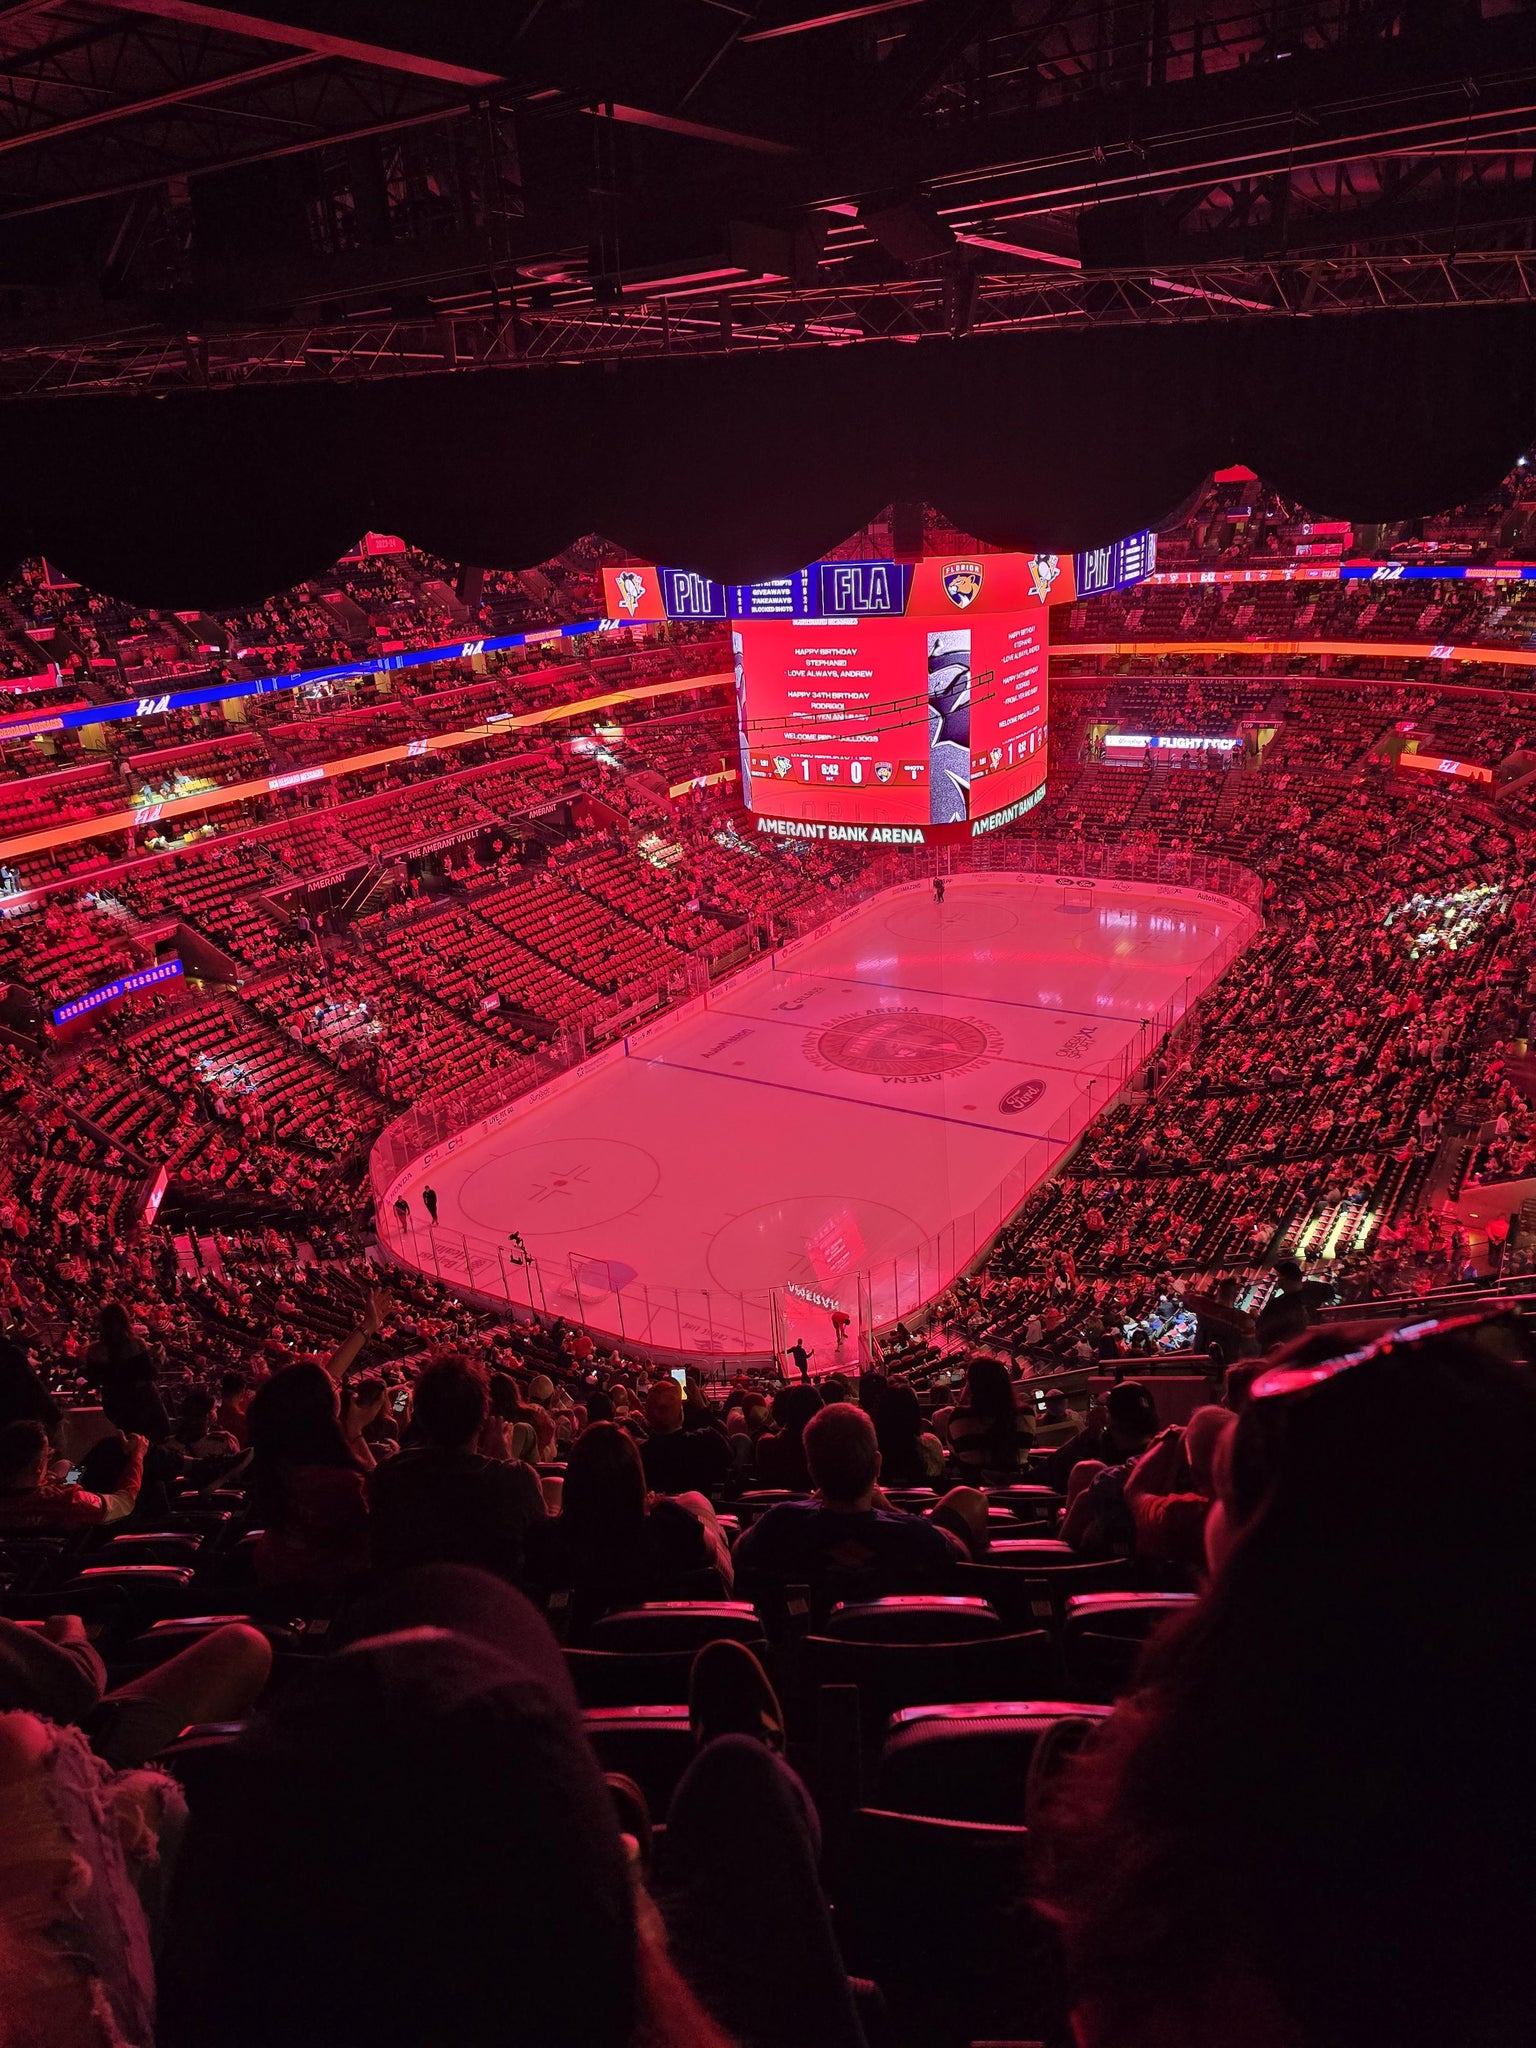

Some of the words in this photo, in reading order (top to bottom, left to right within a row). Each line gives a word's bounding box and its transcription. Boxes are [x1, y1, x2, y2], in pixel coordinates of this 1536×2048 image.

[945, 562, 980, 574] FLORIDA
[673, 573, 712, 612] PIT
[752, 588, 791, 596] GIVEAWAYS
[834, 567, 891, 611] FLA
[751, 597, 793, 605] TAKEAWAYS
[794, 648, 819, 656] HAPPY
[819, 648, 858, 656] BIRTHDAY
[840, 670, 873, 678] ANDREW
[812, 691, 832, 699] 34TH
[1159, 737, 1203, 748] FLIGHT
[801, 759, 810, 781] 1
[821, 763, 839, 776] 6:42
[850, 762, 862, 784] 0
[529, 803, 557, 820] AMERANT
[971, 804, 1019, 837] AMERANT
[757, 817, 827, 839] AMERANT
[828, 826, 870, 842] BANK
[870, 827, 925, 844] ARENA
[408, 847, 421, 859] THE
[420, 838, 455, 857] AMERANT
[455, 829, 479, 847] VAULT
[307, 872, 347, 893] AMERANT
[1198, 891, 1230, 906] AutoNation
[814, 921, 833, 941] DEX
[59, 985, 119, 1020] SCOREBOARD
[124, 964, 178, 990] MESSAGES
[866, 1006, 920, 1016] ARENA
[882, 1073, 943, 1084] ARENA
[1006, 1085, 1039, 1109] Ford
[389, 1172, 413, 1197] HONDA
